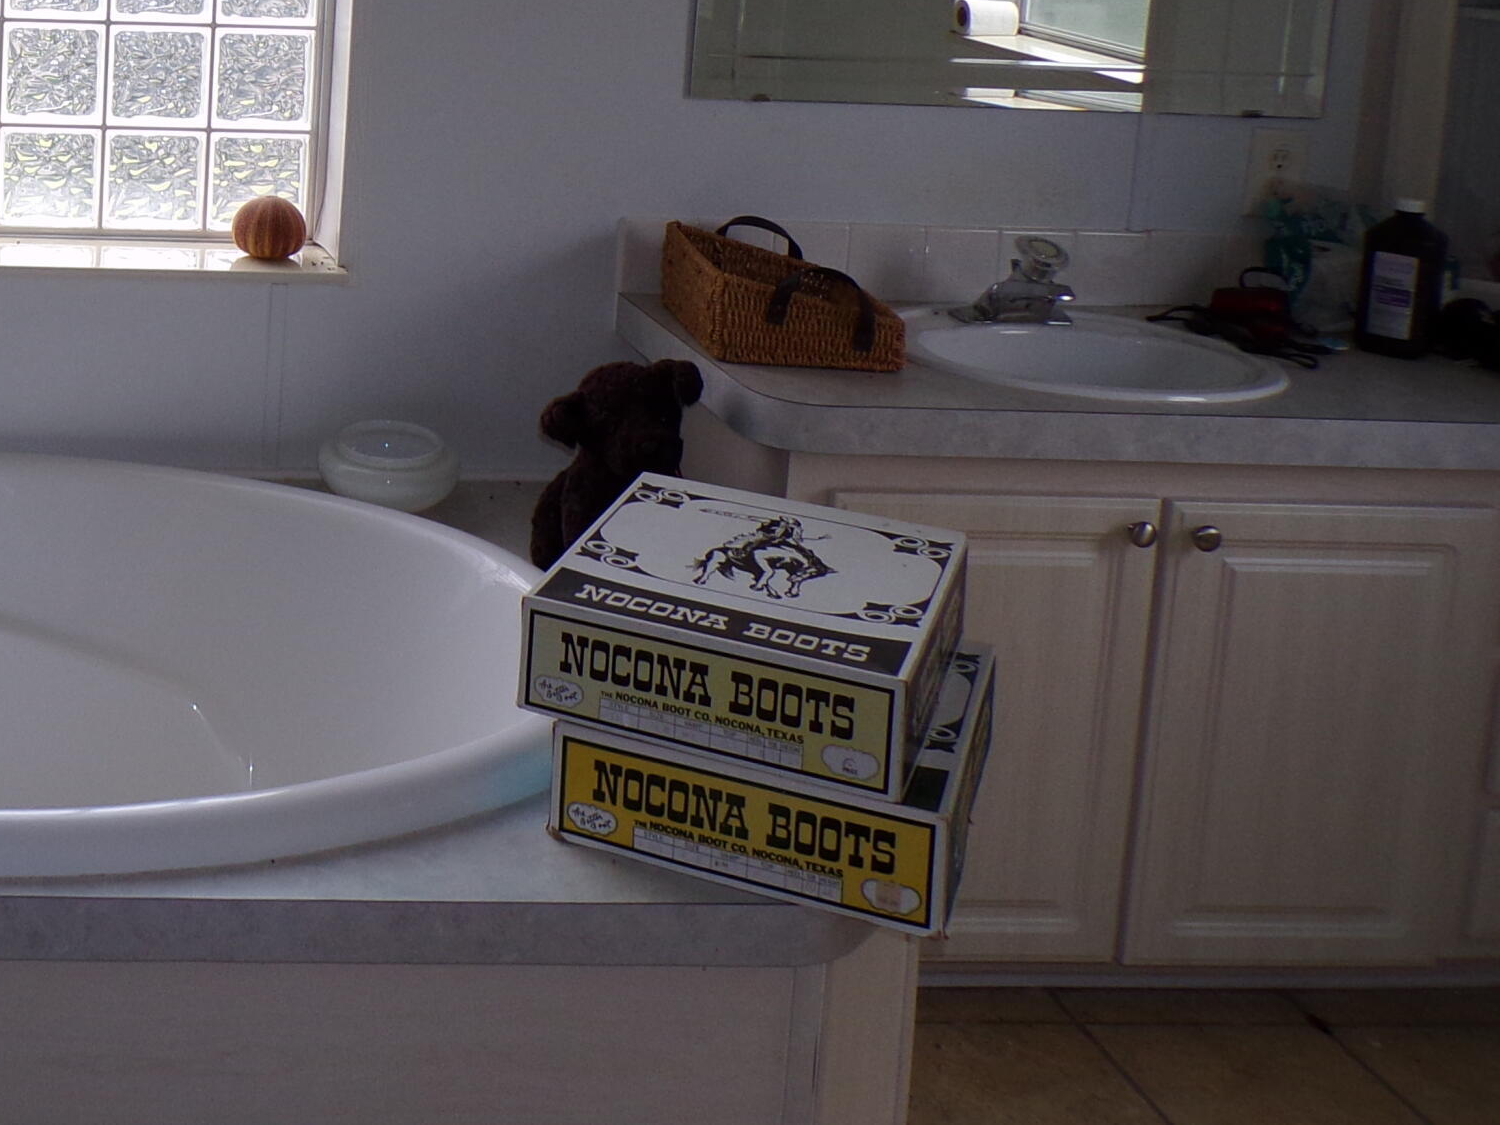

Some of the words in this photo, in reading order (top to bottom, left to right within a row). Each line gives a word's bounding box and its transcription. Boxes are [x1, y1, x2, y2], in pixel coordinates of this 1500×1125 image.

[575, 584, 730, 630] NOCONA
[742, 622, 871, 662] BOOTS
[560, 632, 711, 707] NOCONA
[729, 671, 854, 740] BOOTS
[615, 692, 658, 709] NOCONA
[662, 703, 692, 718] BOOT
[694, 710, 712, 723] CO.
[767, 729, 804, 744] TEXAS
[593, 759, 748, 840] NOCONA
[766, 803, 896, 874] BOOTS
[650, 821, 694, 841] NOCONA
[699, 833, 728, 849] BOOT
[805, 861, 843, 877] TEXAS
